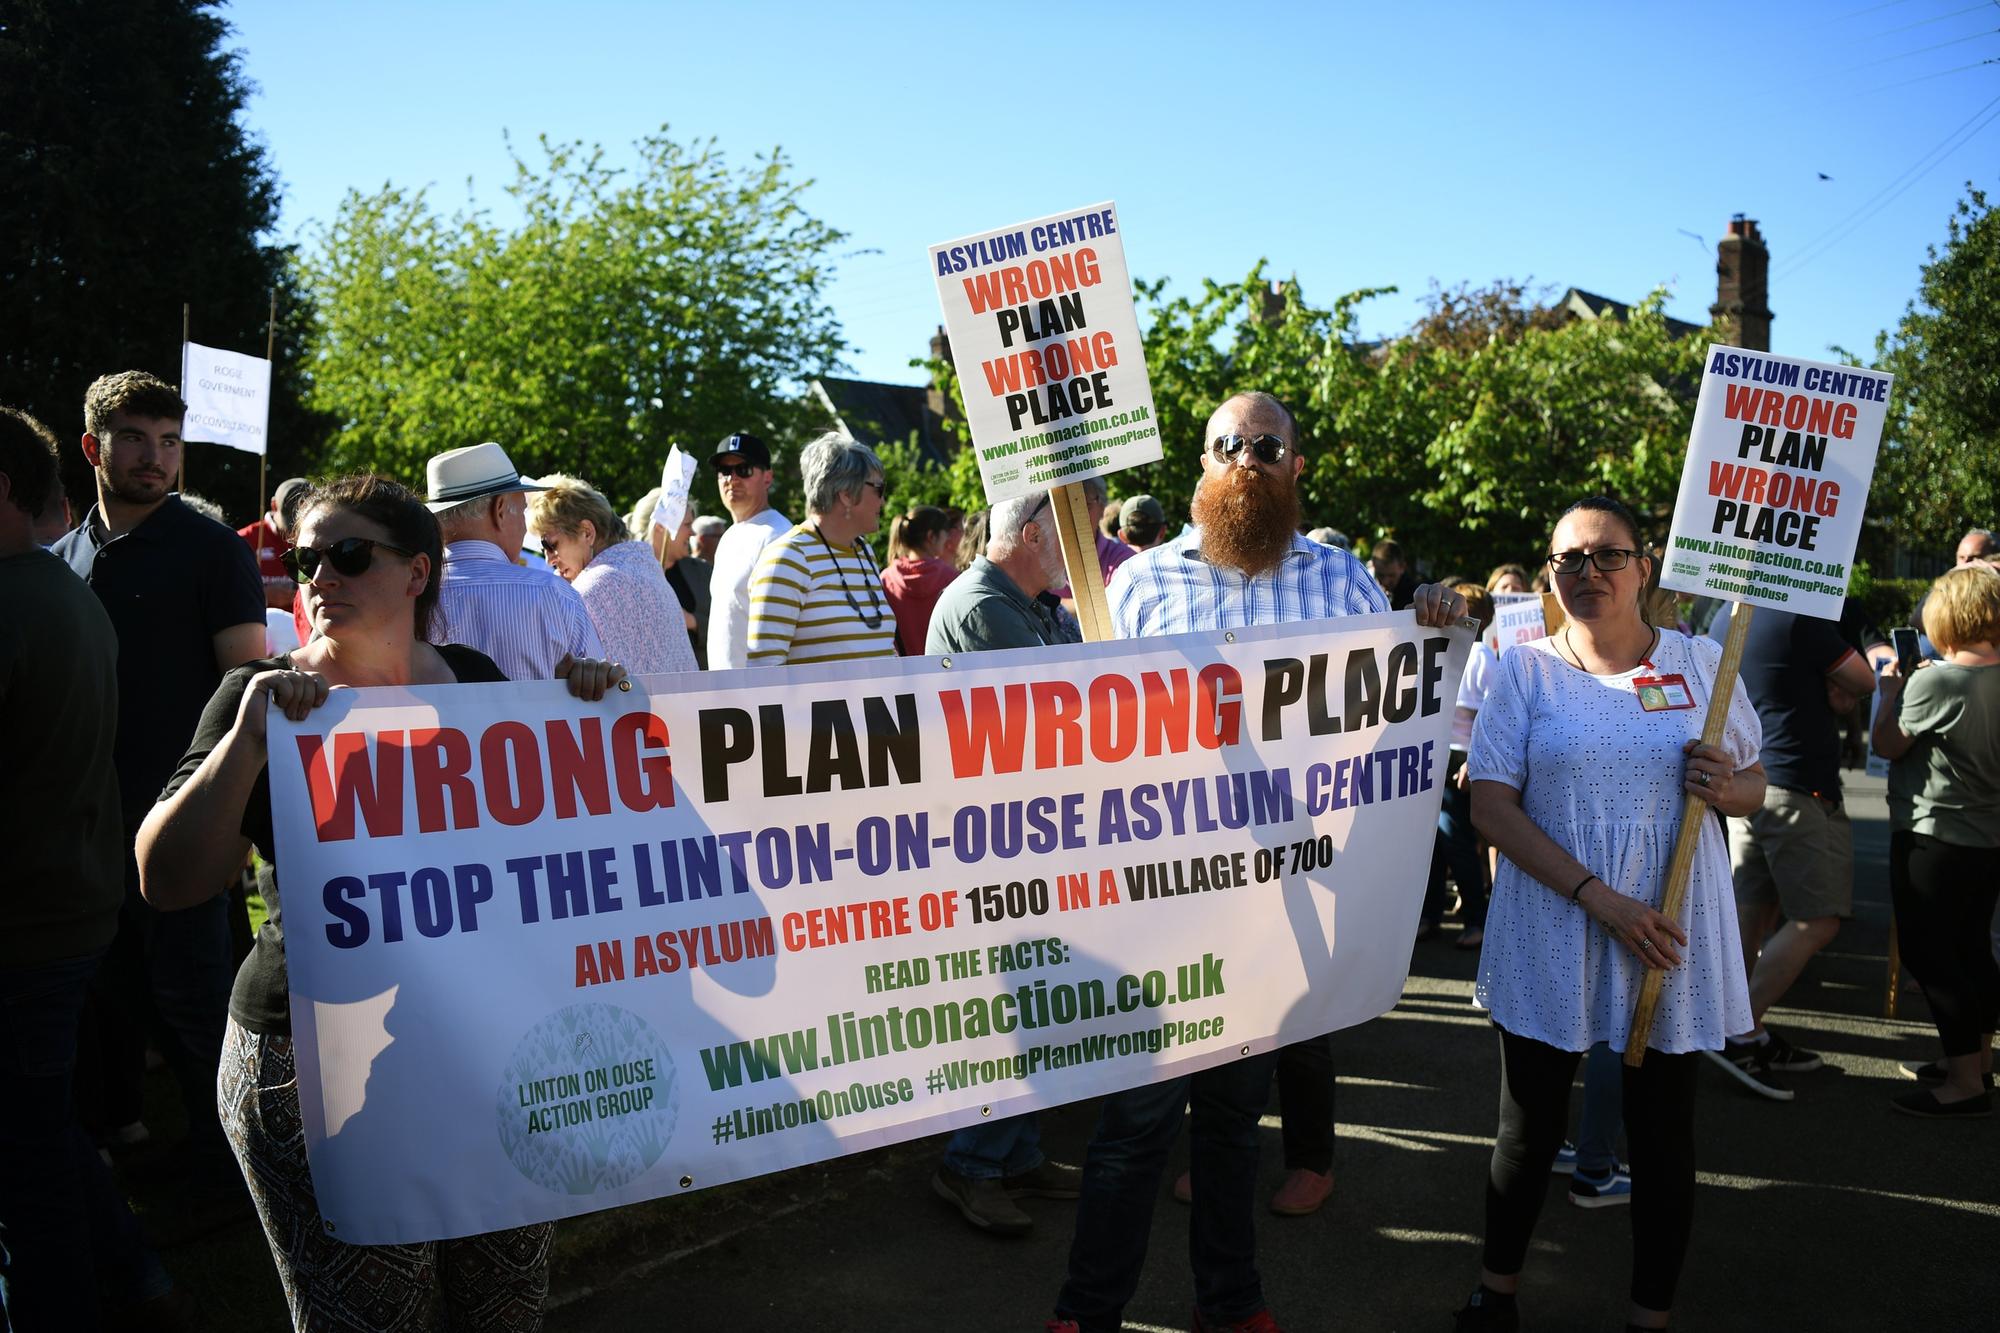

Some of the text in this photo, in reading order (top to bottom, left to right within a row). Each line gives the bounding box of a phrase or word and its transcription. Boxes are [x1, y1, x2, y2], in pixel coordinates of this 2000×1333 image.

[936, 210, 1116, 276] ASYLUM CENTRE
[962, 247, 1102, 315] WRONG
[996, 291, 1087, 348] PLAN
[982, 331, 1118, 397] WRONG
[1710, 352, 1889, 403] ASYLUM CENTRE
[1006, 372, 1113, 431] PLACE
[1724, 384, 1858, 440] WRONG
[982, 405, 1150, 461] www.lintonaction.co.uk
[1025, 426, 1157, 469] #WrongPlanWrongPlace
[1737, 425, 1828, 472] PLAN
[1028, 455, 1110, 484] #LintonOnOuse
[1708, 461, 1841, 518] WRONG
[1712, 500, 1820, 551] PLACE
[1675, 536, 1845, 579] www.lintonaction.co.uk
[1709, 563, 1844, 597] #WrongPlanWrongPlace
[1705, 578, 1789, 603] #LintonOnOuse
[296, 638, 1450, 842] WRONG PLAN WRONG PLACE
[323, 740, 1434, 949] STOP THE LINTON-ON-OUSE ASYLUM CENTRE
[575, 835, 1333, 987] AN ASYLUM CENTRE OF 1500 IN A VILLAGE OF 700
[865, 936, 1070, 993] READ THE FACTS:
[699, 952, 1225, 1092] www.lintonaction.co.uk
[519, 1059, 656, 1107] LINTON ON OUSE
[711, 1016, 1224, 1146] #LintonOnOuse #WrongPlanWrongPlace
[527, 1087, 654, 1135] ACTION GROUP
